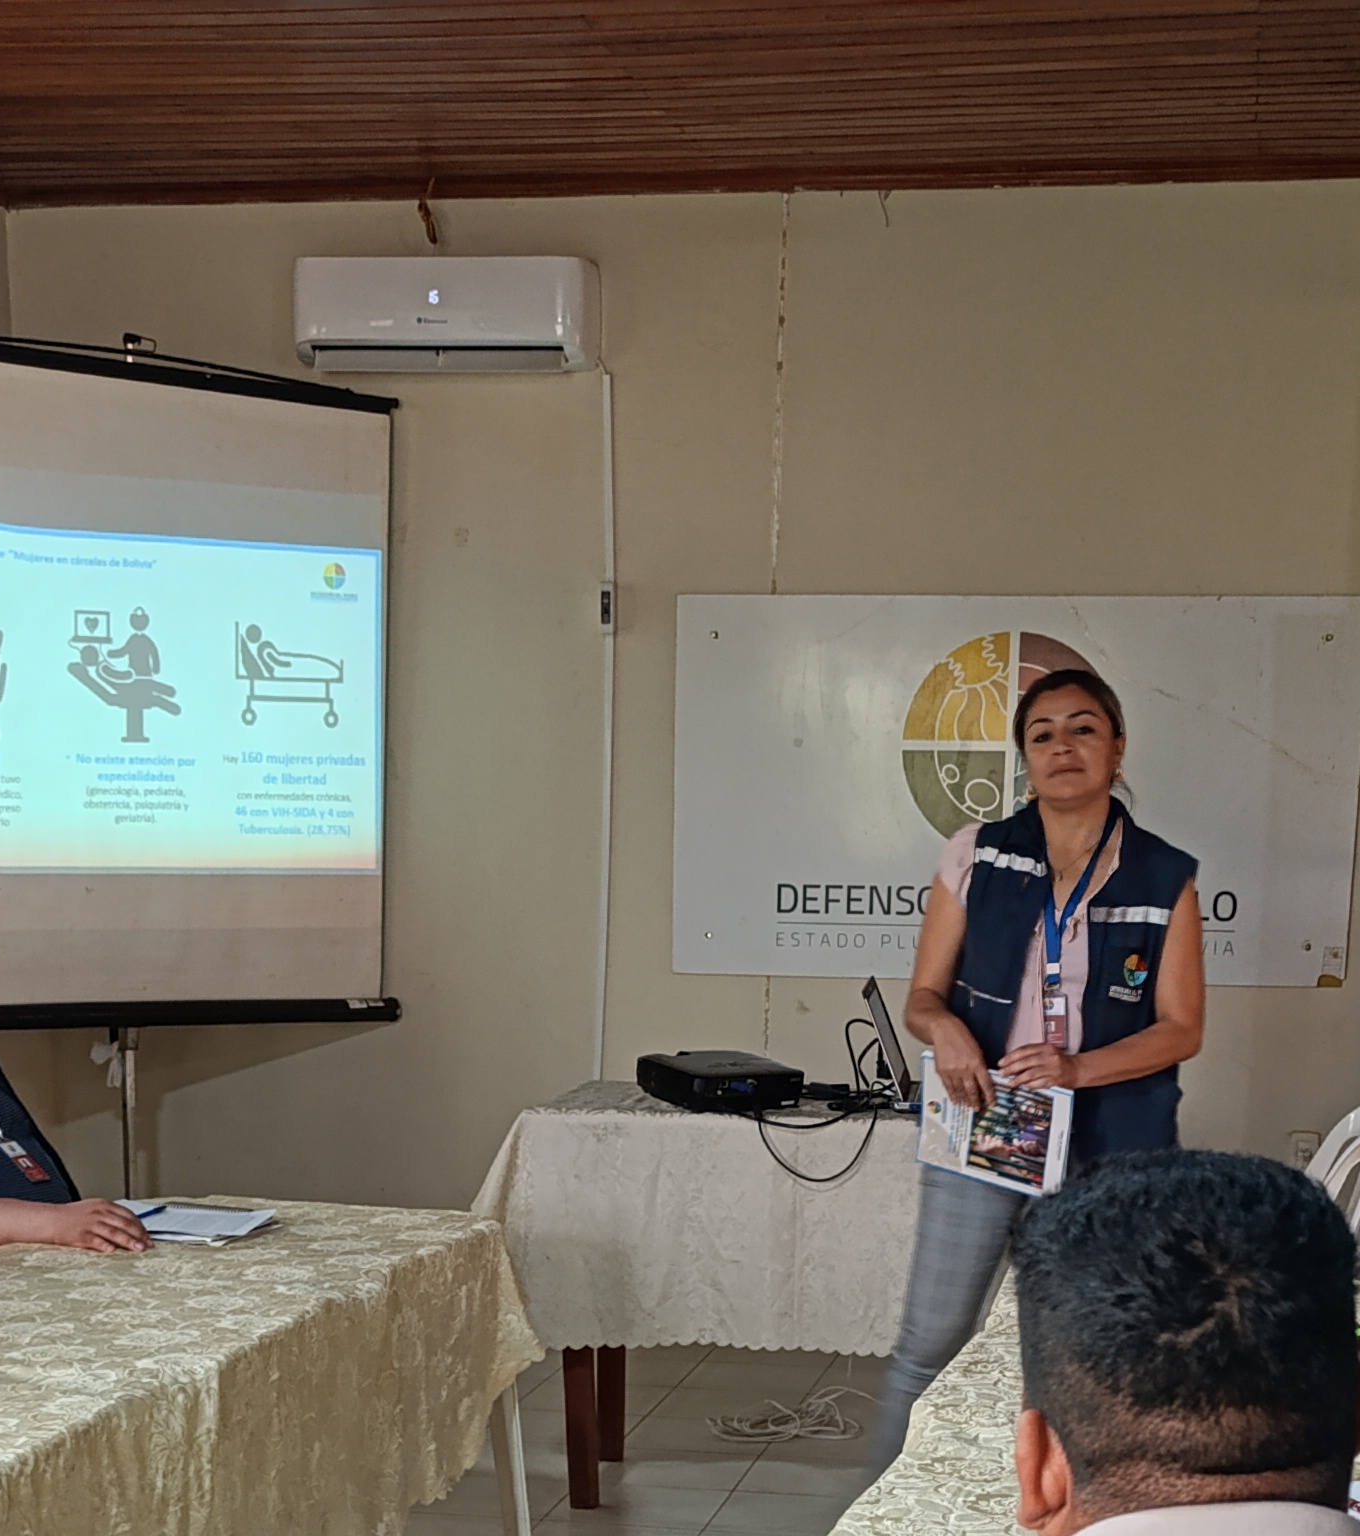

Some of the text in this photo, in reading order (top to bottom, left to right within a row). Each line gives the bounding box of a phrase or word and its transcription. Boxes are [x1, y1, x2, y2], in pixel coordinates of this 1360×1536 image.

[56, 556, 68, 564] en
[109, 557, 120, 567] de
[76, 753, 195, 768] No existe atención por
[222, 751, 366, 767] Hay 160 mujeres privadas
[0, 774, 21, 783] tuvo
[97, 770, 175, 783] especialidades
[263, 773, 327, 785] de libertad
[254, 791, 314, 801] enfermedades
[183, 803, 189, 811] y
[235, 806, 354, 820] 46 con VIH-SIDA y 4 con
[239, 823, 351, 836] Tuberculosis. (28,75%)
[775, 931, 866, 949] ESTADO
